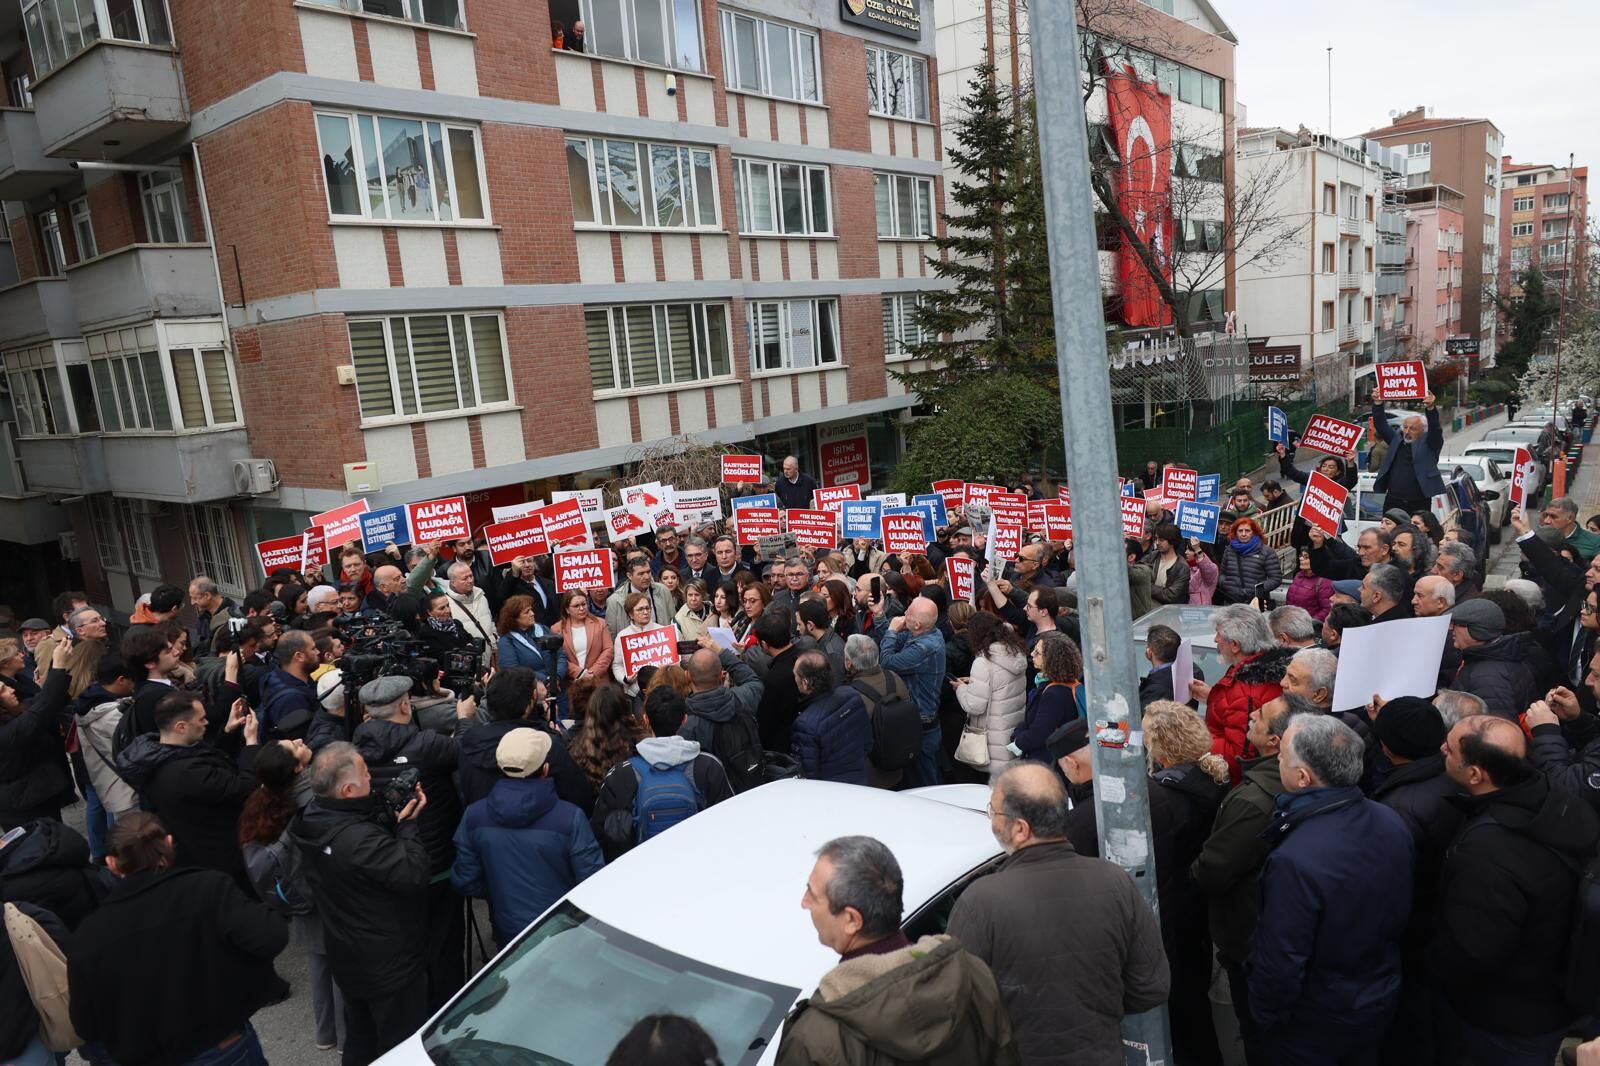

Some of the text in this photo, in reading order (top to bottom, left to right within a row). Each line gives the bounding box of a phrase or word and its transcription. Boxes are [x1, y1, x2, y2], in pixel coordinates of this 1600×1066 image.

[1381, 363, 1417, 377] İSMAİL
[1383, 377, 1417, 389] ARI'YA
[1384, 389, 1417, 397] ÖZGÜRLÜK
[1312, 419, 1355, 439] ALİCAN
[1308, 429, 1348, 448] ULUDAĞ'A
[1304, 438, 1345, 455] ÖZGÜRLÜK
[724, 468, 759, 476] ÖZGÜRLÜK
[1168, 471, 1195, 482] ALİCAN
[1167, 481, 1194, 491] ULUDAĞ'A
[820, 488, 853, 501] İSMAİL
[1167, 489, 1194, 499] ÖZGÜRLÜK
[416, 502, 462, 519] ALİCAN
[1121, 499, 1143, 513] LİCAN
[1306, 494, 1341, 523] ÖZGÜRLÜK
[364, 513, 397, 527] MEMLEKETE
[417, 515, 463, 530] ULUDAĞ'A
[544, 517, 583, 533] NINDAYIZ!
[888, 519, 922, 530] ALİCAN
[365, 523, 395, 536] ÖZGÜRLÜK
[419, 526, 465, 540] ÖZGÜRLÜK
[490, 526, 542, 545] İSMAİL ARI'NIN
[741, 526, 760, 534] İSMAİL
[792, 528, 812, 536] İSMAİL
[367, 532, 395, 544] İSTİYORUZ
[492, 535, 544, 552] YANINDAYIZ!
[797, 536, 828, 544] ÖZGÜRLÜK
[890, 541, 924, 551] ÖZGÜRLÜK
[560, 553, 602, 568] İSMAİL
[561, 569, 603, 582] ARI'YA
[562, 579, 604, 590] ÖZGÜRLÜK
[626, 631, 669, 651] İSMAİL
[630, 645, 671, 663] ARI'YA
